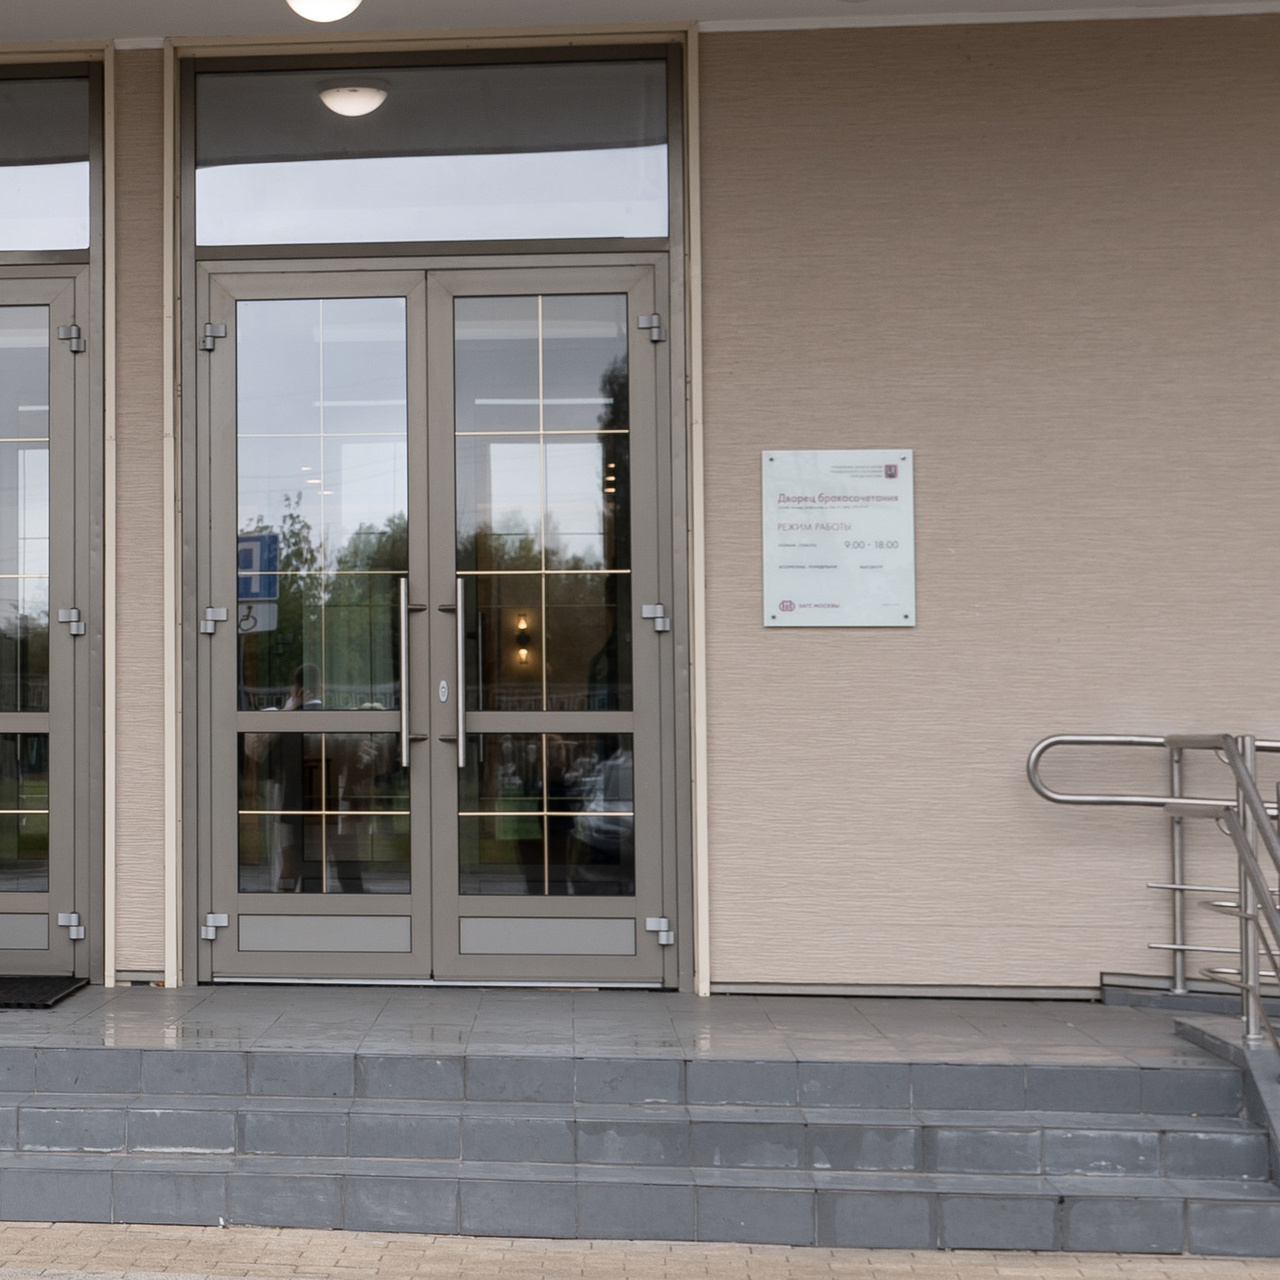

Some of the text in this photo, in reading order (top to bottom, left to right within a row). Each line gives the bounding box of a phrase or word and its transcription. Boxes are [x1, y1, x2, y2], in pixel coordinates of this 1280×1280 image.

[778, 493, 899, 504] Дворец бракосочетания
[777, 522, 852, 531] РЕЖИМ РАБОТЫ
[844, 540, 866, 549] 9:00
[874, 540, 899, 549] 18:00
